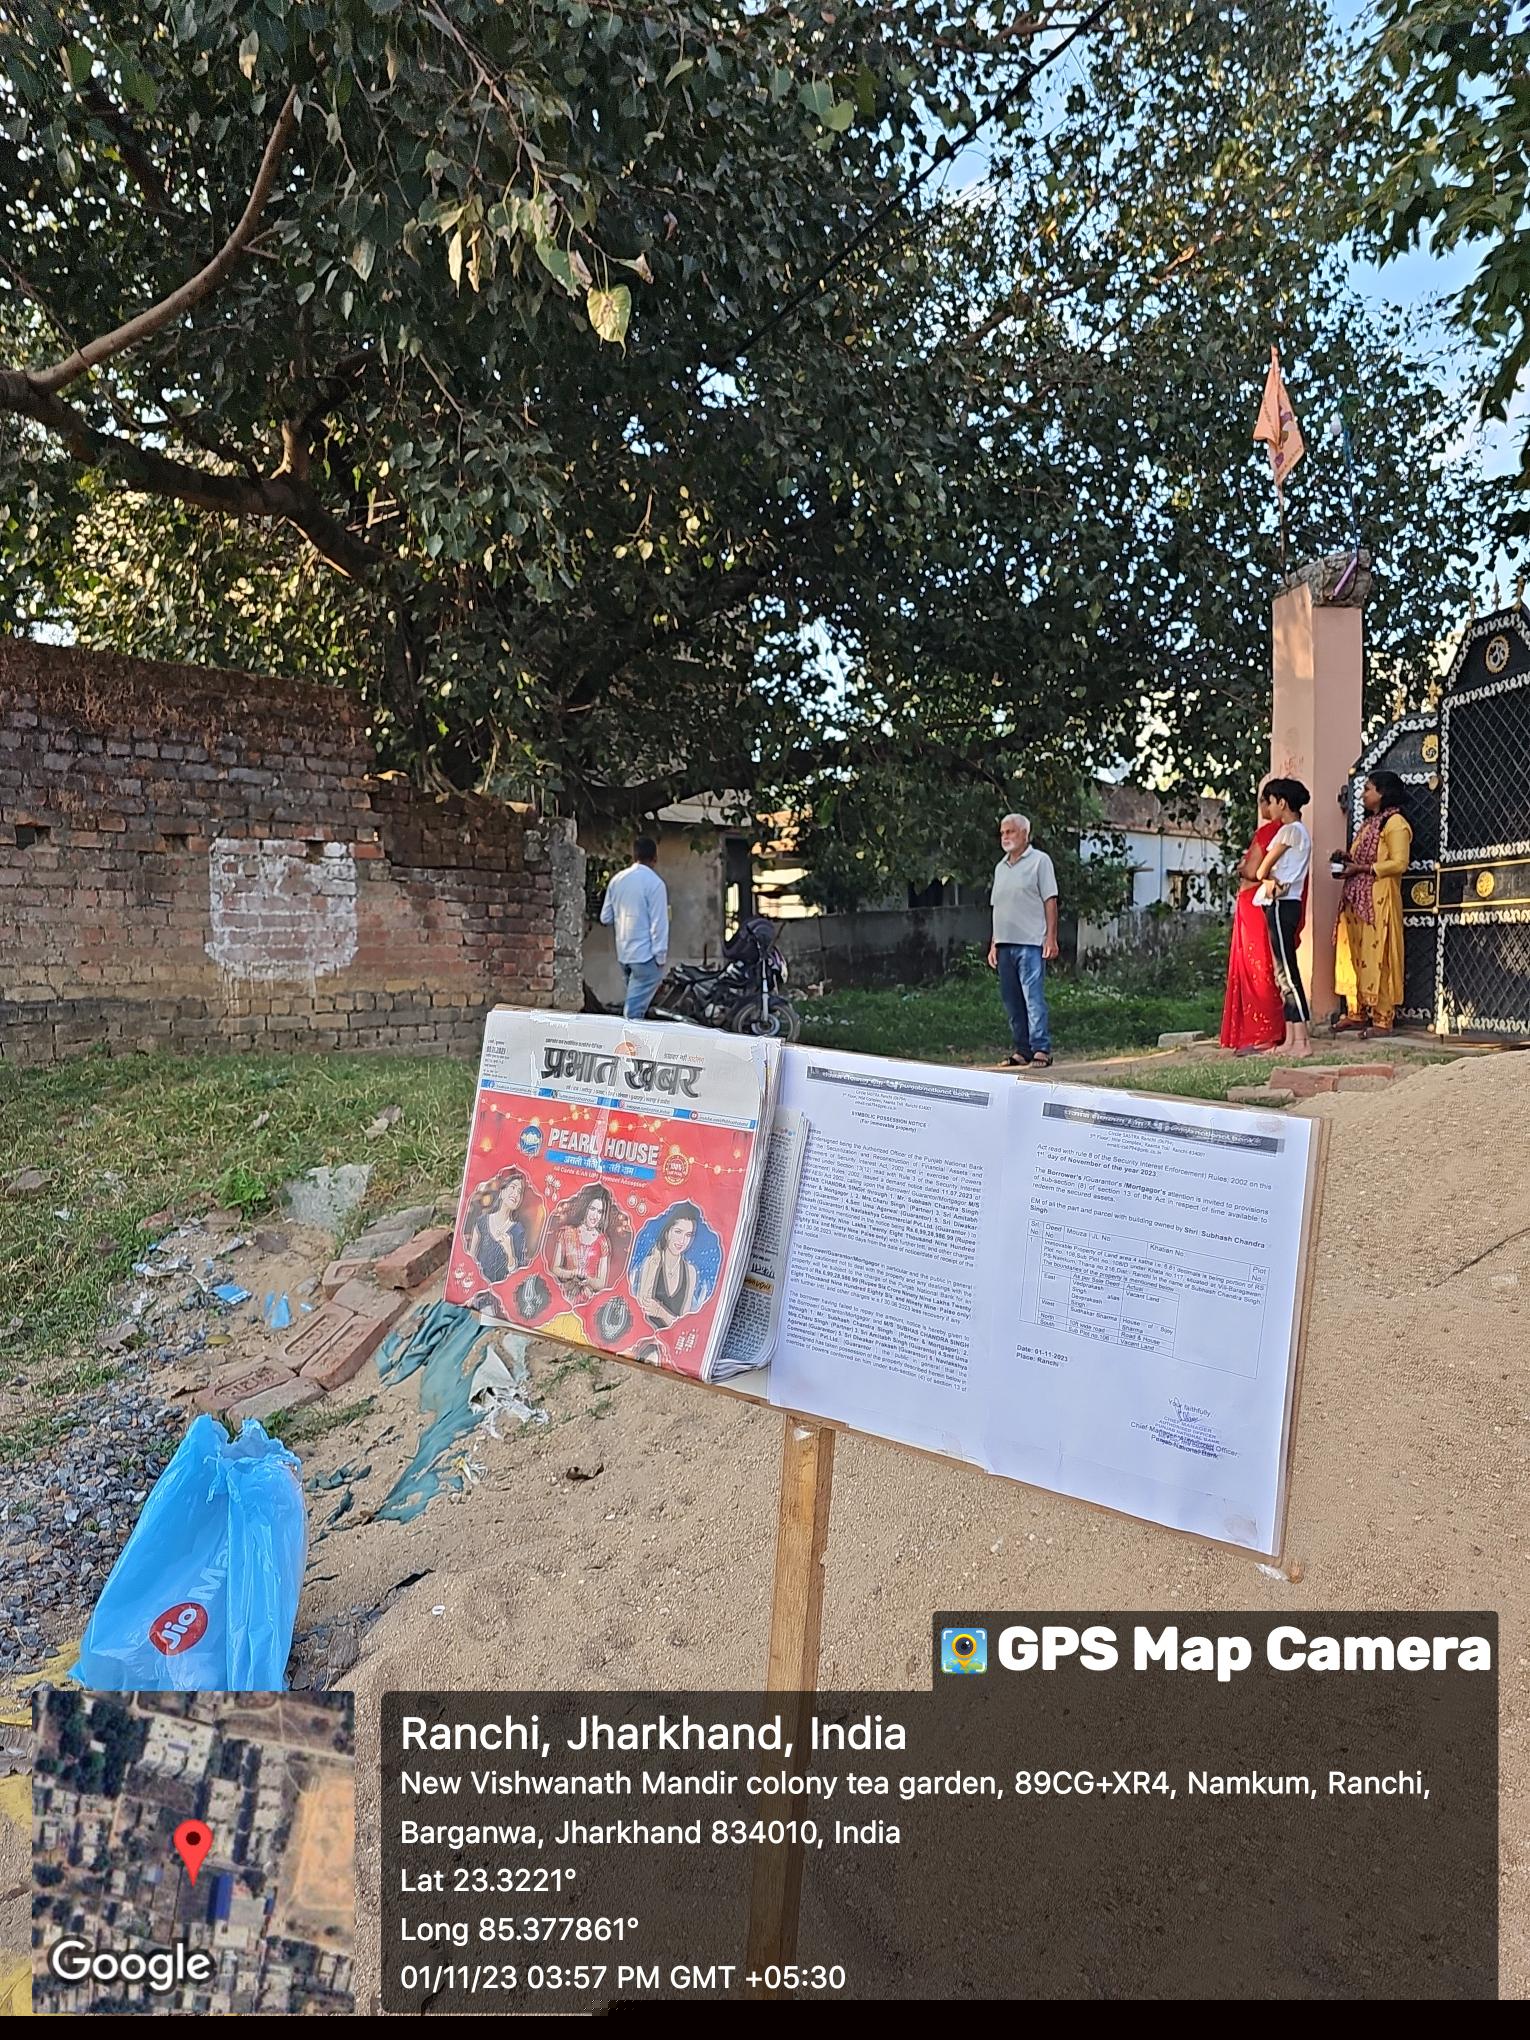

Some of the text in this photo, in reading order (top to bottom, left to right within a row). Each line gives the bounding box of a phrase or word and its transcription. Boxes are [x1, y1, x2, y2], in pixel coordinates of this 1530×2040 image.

[541, 1047, 620, 1086] प्रभात
[625, 1058, 703, 1098] खबर
[851, 1111, 875, 1119] SYMBOLIC
[876, 1115, 907, 1124] POSSESSION
[548, 1127, 599, 1155] PEARL
[604, 1137, 660, 1166] HOUSE
[862, 1145, 888, 1154] Authorized
[923, 1156, 942, 1165] Punjab
[944, 1159, 967, 1168] National
[1047, 1153, 1057, 1161] day
[1067, 1156, 1103, 1167] November
[1111, 1163, 1122, 1171] the
[1123, 1167, 1138, 1175] year
[1048, 1145, 1061, 1153] read
[1112, 1156, 1138, 1167] Security
[1139, 1161, 1163, 1170] Interest
[1164, 1165, 1206, 1179] Enforcement)
[1230, 1177, 1247, 1185] 2002
[1259, 1182, 1271, 1190] this
[1032, 1181, 1054, 1191] redeem
[1066, 1188, 1091, 1197] secured
[1041, 1175, 1075, 1186] sub-section
[1097, 1185, 1120, 1194] section
[1154, 1195, 1165, 1203] Act
[1175, 1199, 1199, 1211] respect
[1201, 1204, 1208, 1212] of
[1210, 1206, 1225, 1215] time
[1227, 1210, 1258, 1221] available
[1047, 1168, 1082, 1180] Borrower's
[1083, 1175, 1122, 1187] /Guarantor's
[1123, 1182, 1166, 1196] /Mortgagor's
[1167, 1190, 1194, 1200] attention
[1202, 1196, 1224, 1206] invited
[1233, 1202, 1268, 1216] provisions
[907, 1197, 931, 1206] Subhash
[934, 1202, 958, 1211] Chandra
[961, 1207, 978, 1217] Singh
[1029, 1204, 1048, 1214] Singh
[1066, 1228, 1087, 1237] Mouza
[1067, 1204, 1079, 1213] part
[1080, 1206, 1092, 1214] and
[1093, 1209, 1113, 1219] parcel
[1114, 1212, 1127, 1220] with
[1128, 1215, 1152, 1227] building
[1153, 1220, 1174, 1230] owned
[1175, 1224, 1183, 1233] by
[1184, 1226, 1198, 1235] Shri
[1201, 1230, 1232, 1242] Subhash
[1233, 1236, 1264, 1248] Chandra
[1125, 1290, 1159, 1302] Vacant Land
[1015, 1351, 1059, 1367] Place: Ranchi
[1016, 1343, 1068, 1362] Date: 01-11-2023
[1130, 1421, 1148, 1431] Chief
[161, 1608, 197, 1650] Jio
